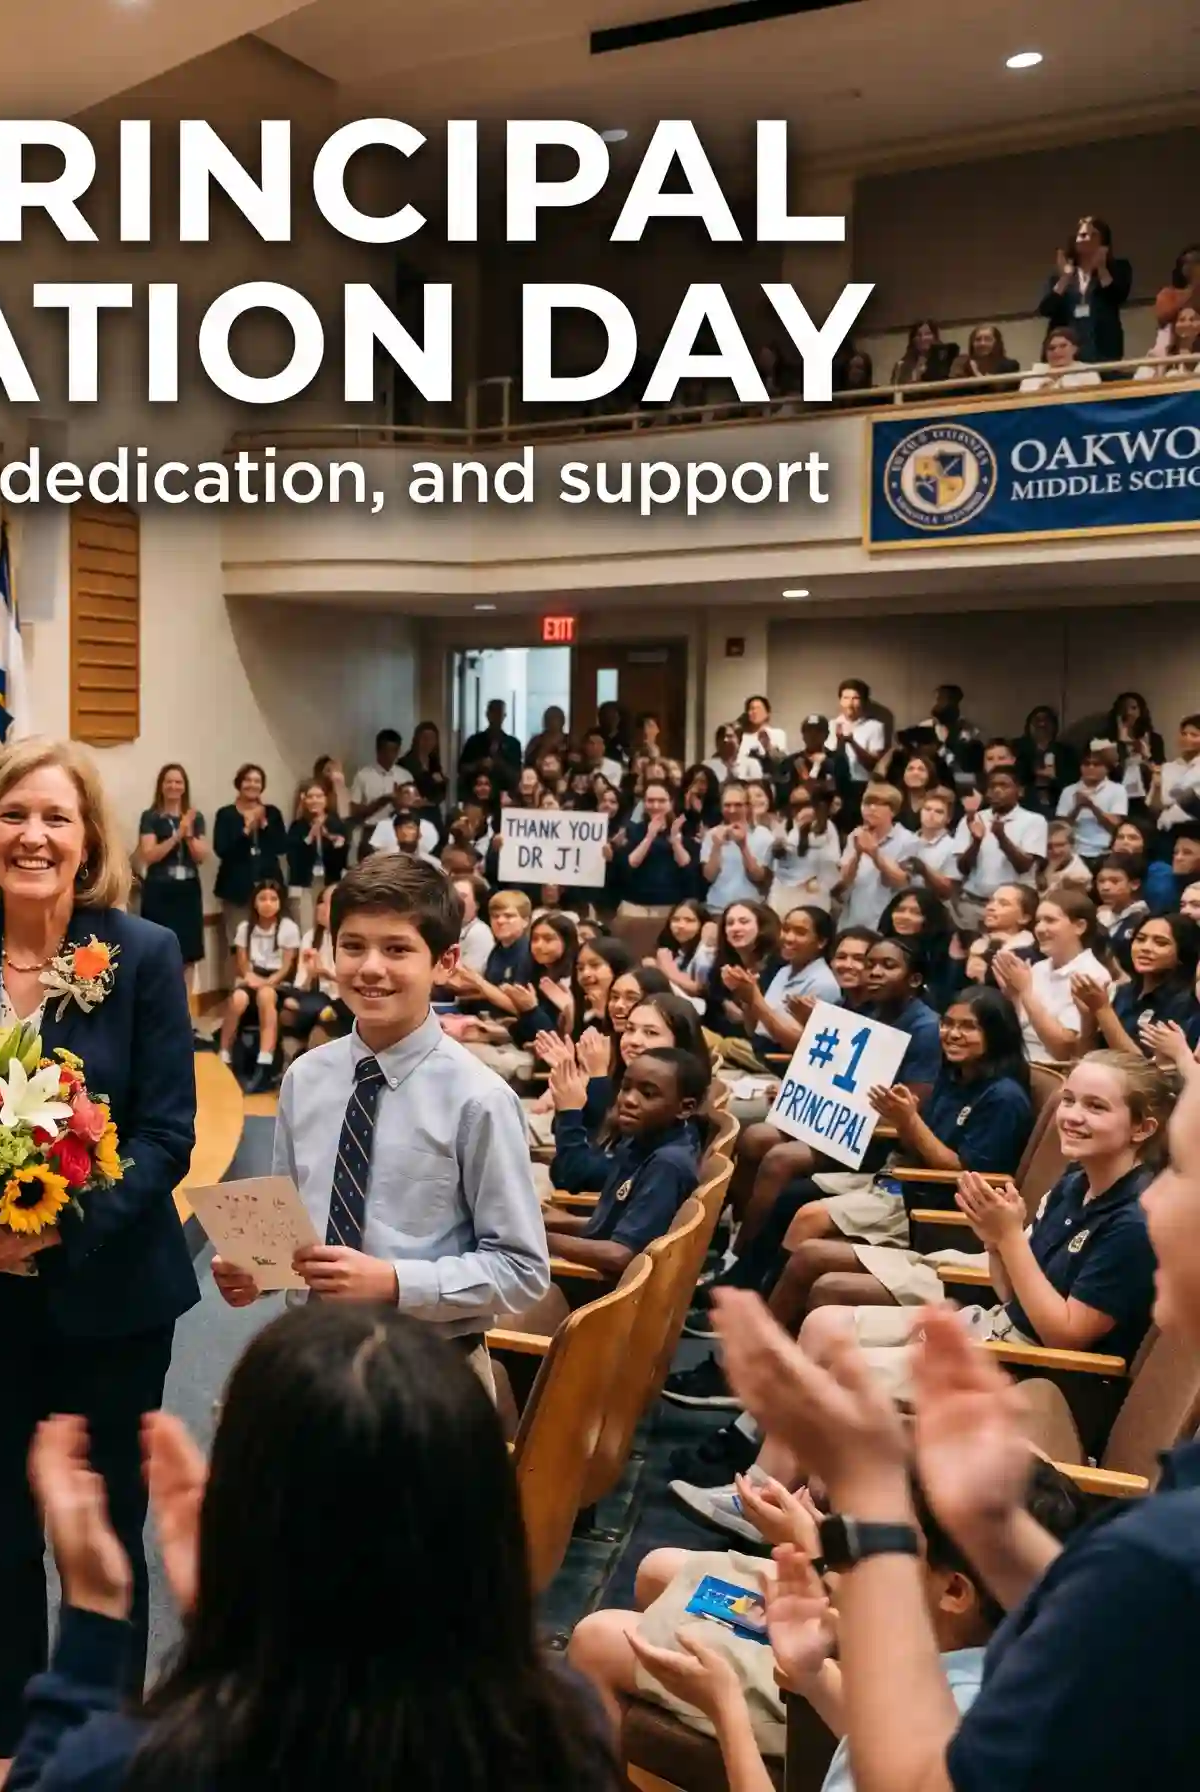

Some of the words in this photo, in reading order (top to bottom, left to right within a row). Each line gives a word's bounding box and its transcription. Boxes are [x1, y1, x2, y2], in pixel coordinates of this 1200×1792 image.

[1011, 472, 1123, 501] MIDDLE
[543, 616, 574, 641] EXIT
[506, 818, 561, 840] THANK
[569, 820, 604, 842] YOU
[517, 846, 543, 868] DR
[555, 847, 581, 874] J!
[809, 1027, 872, 1094] #1
[775, 1079, 868, 1156] PRINCIPAL
